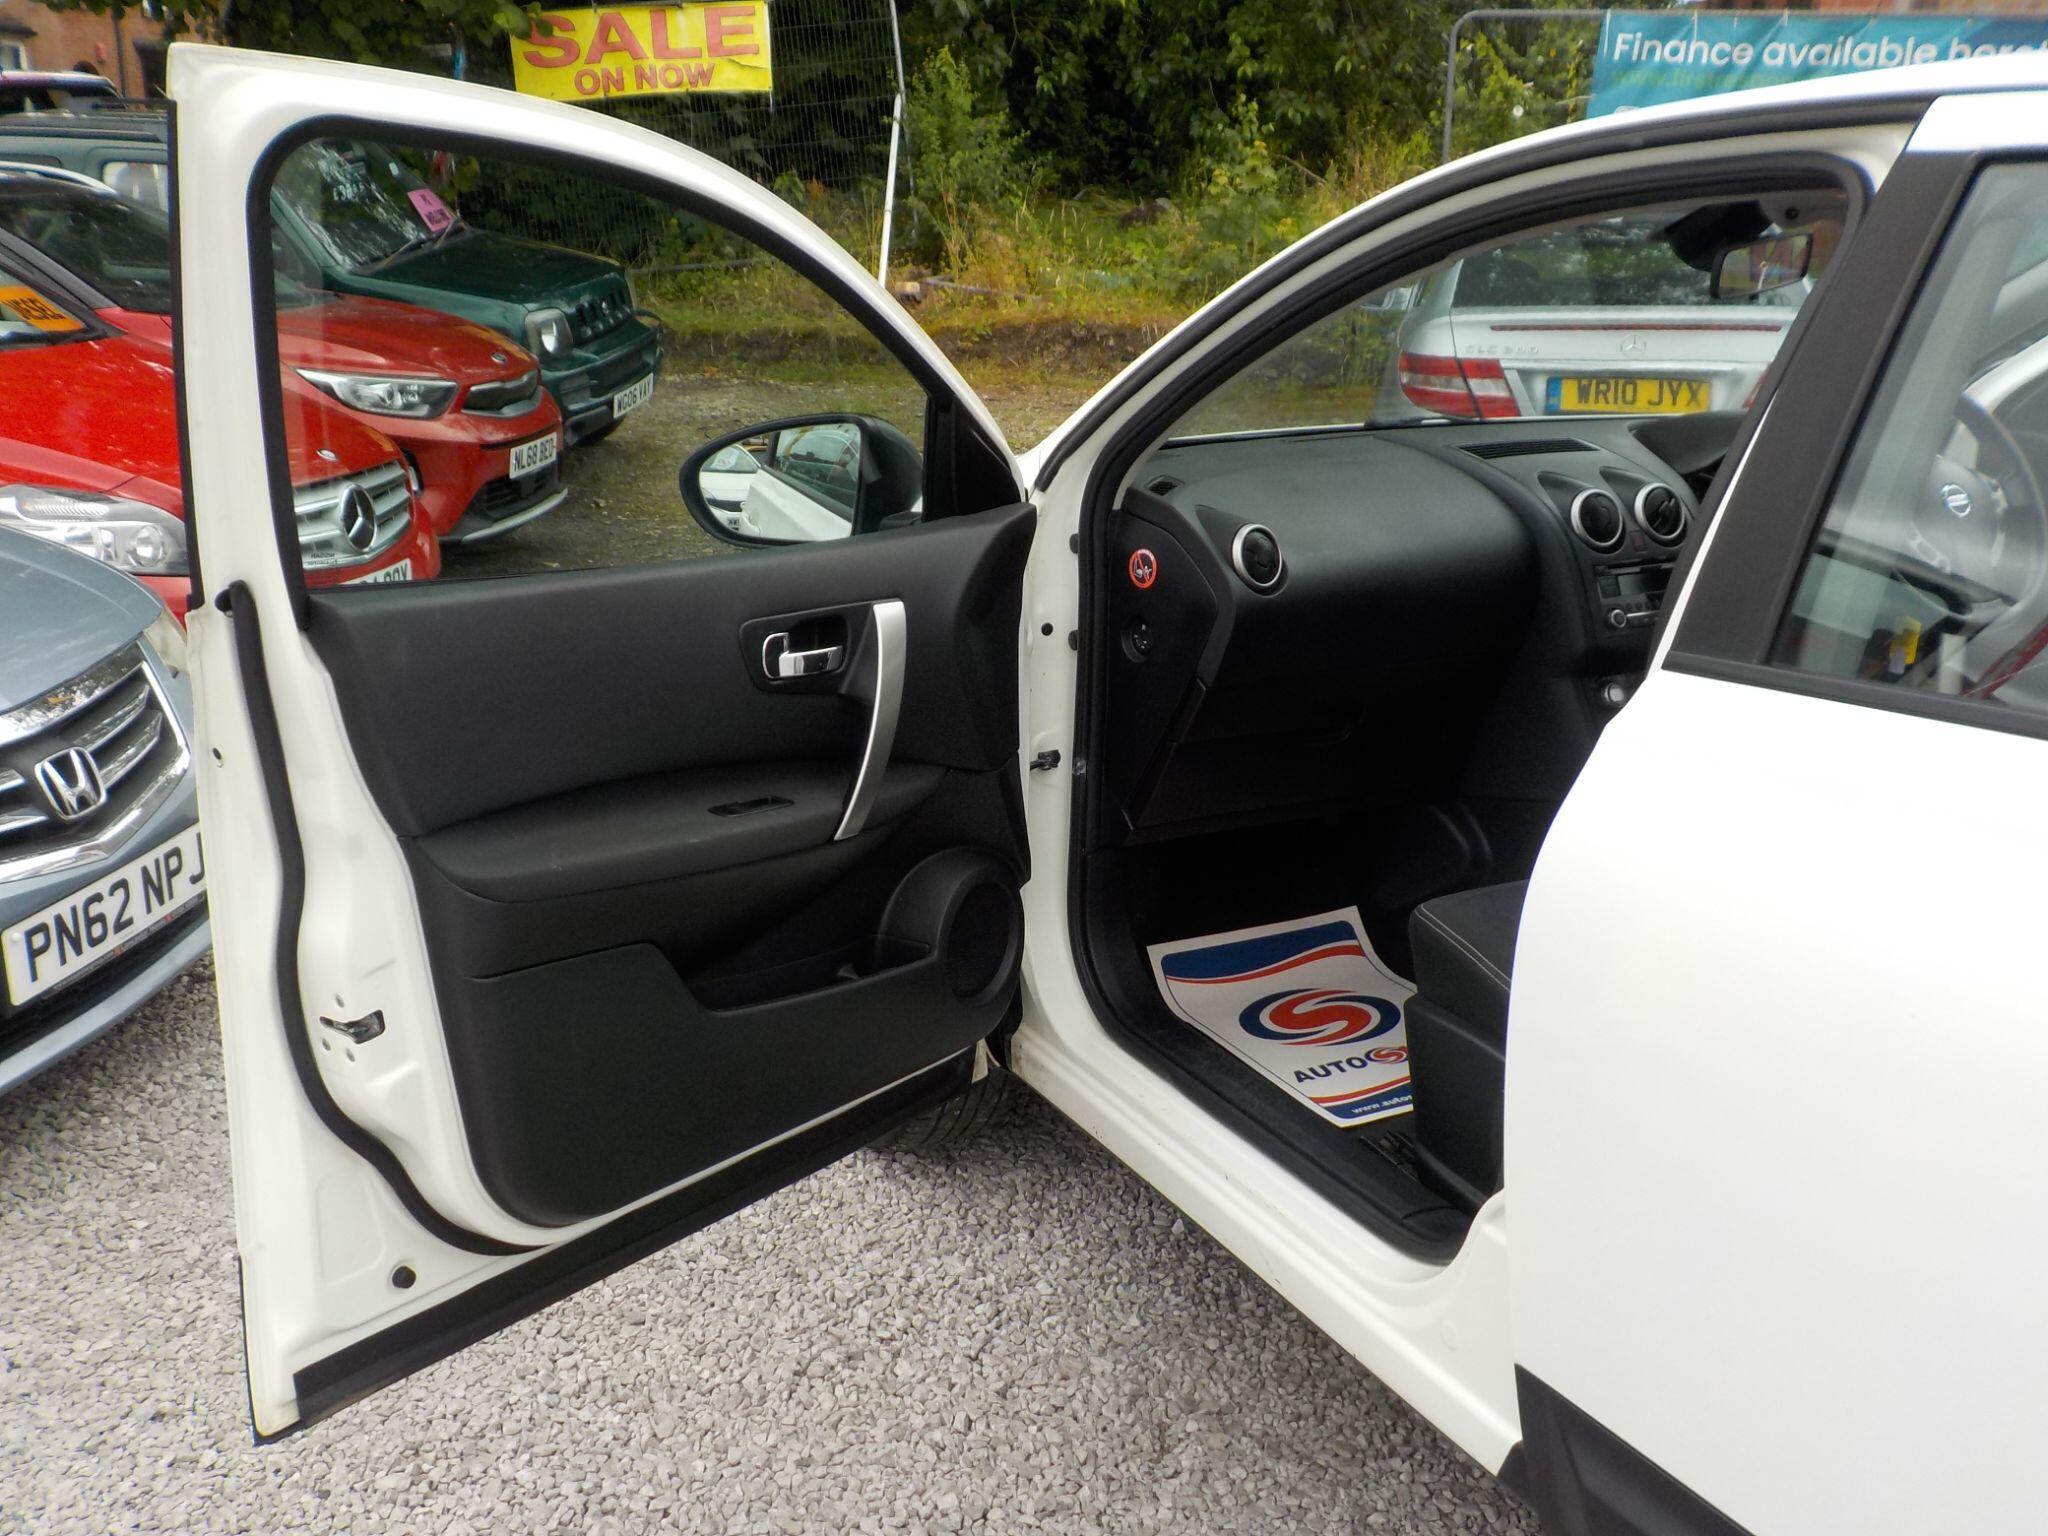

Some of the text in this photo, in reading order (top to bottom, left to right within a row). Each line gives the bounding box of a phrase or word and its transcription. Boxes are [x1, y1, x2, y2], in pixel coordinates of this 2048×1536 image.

[523, 6, 760, 68] SALE
[1613, 32, 1754, 66] Finance
[1762, 36, 1938, 67] available
[574, 62, 715, 96] ON NOW
[1576, 378, 1702, 407] WR10 JYX
[514, 444, 537, 472] NL68
[24, 877, 134, 983] PN62
[140, 832, 206, 915] NPJ
